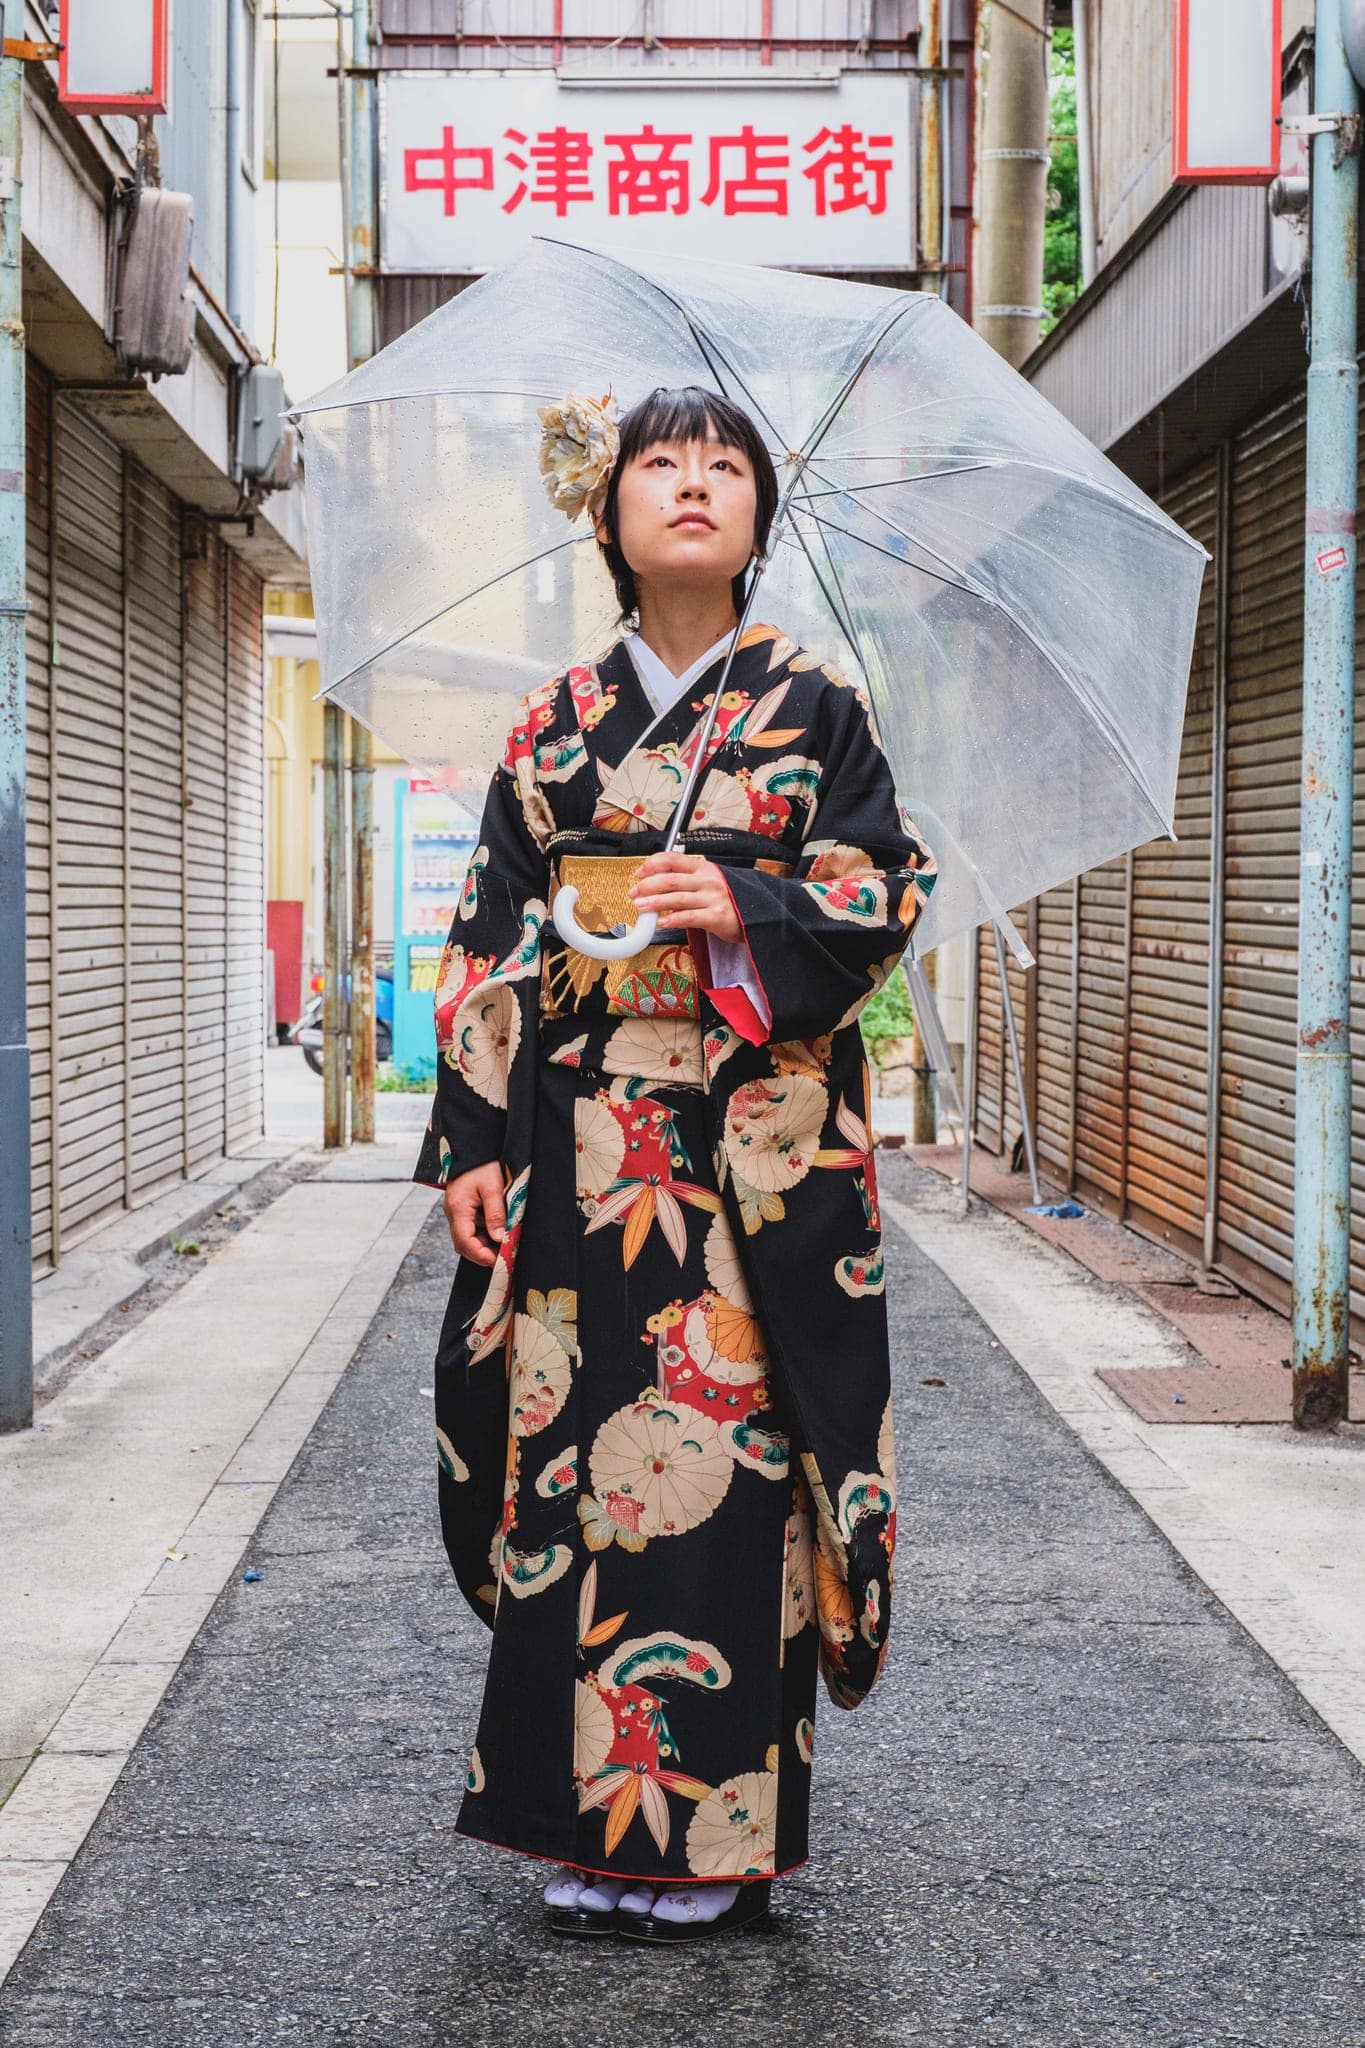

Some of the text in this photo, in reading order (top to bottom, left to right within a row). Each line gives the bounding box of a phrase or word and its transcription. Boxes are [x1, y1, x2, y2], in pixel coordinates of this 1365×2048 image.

[404, 124, 893, 217] 中津商店街
